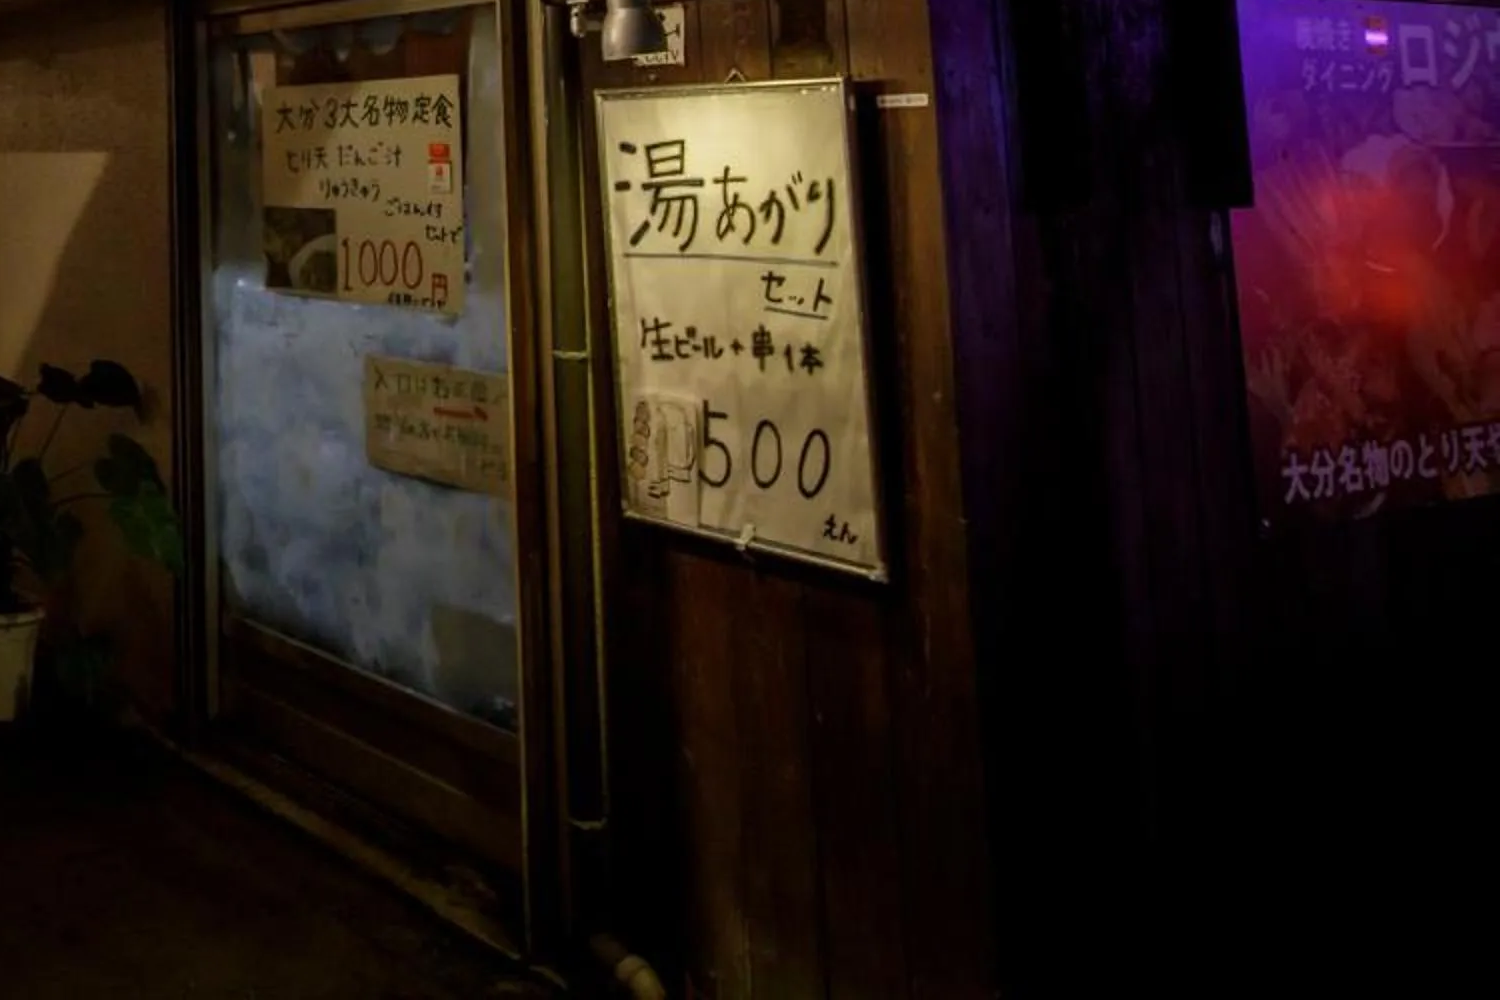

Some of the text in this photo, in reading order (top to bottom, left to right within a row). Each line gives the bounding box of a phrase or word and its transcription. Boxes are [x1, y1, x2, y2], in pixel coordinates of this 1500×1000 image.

[613, 137, 836, 255] 湯あがり
[759, 271, 834, 311] セット
[699, 401, 833, 499] 500
[820, 514, 859, 546] えん
